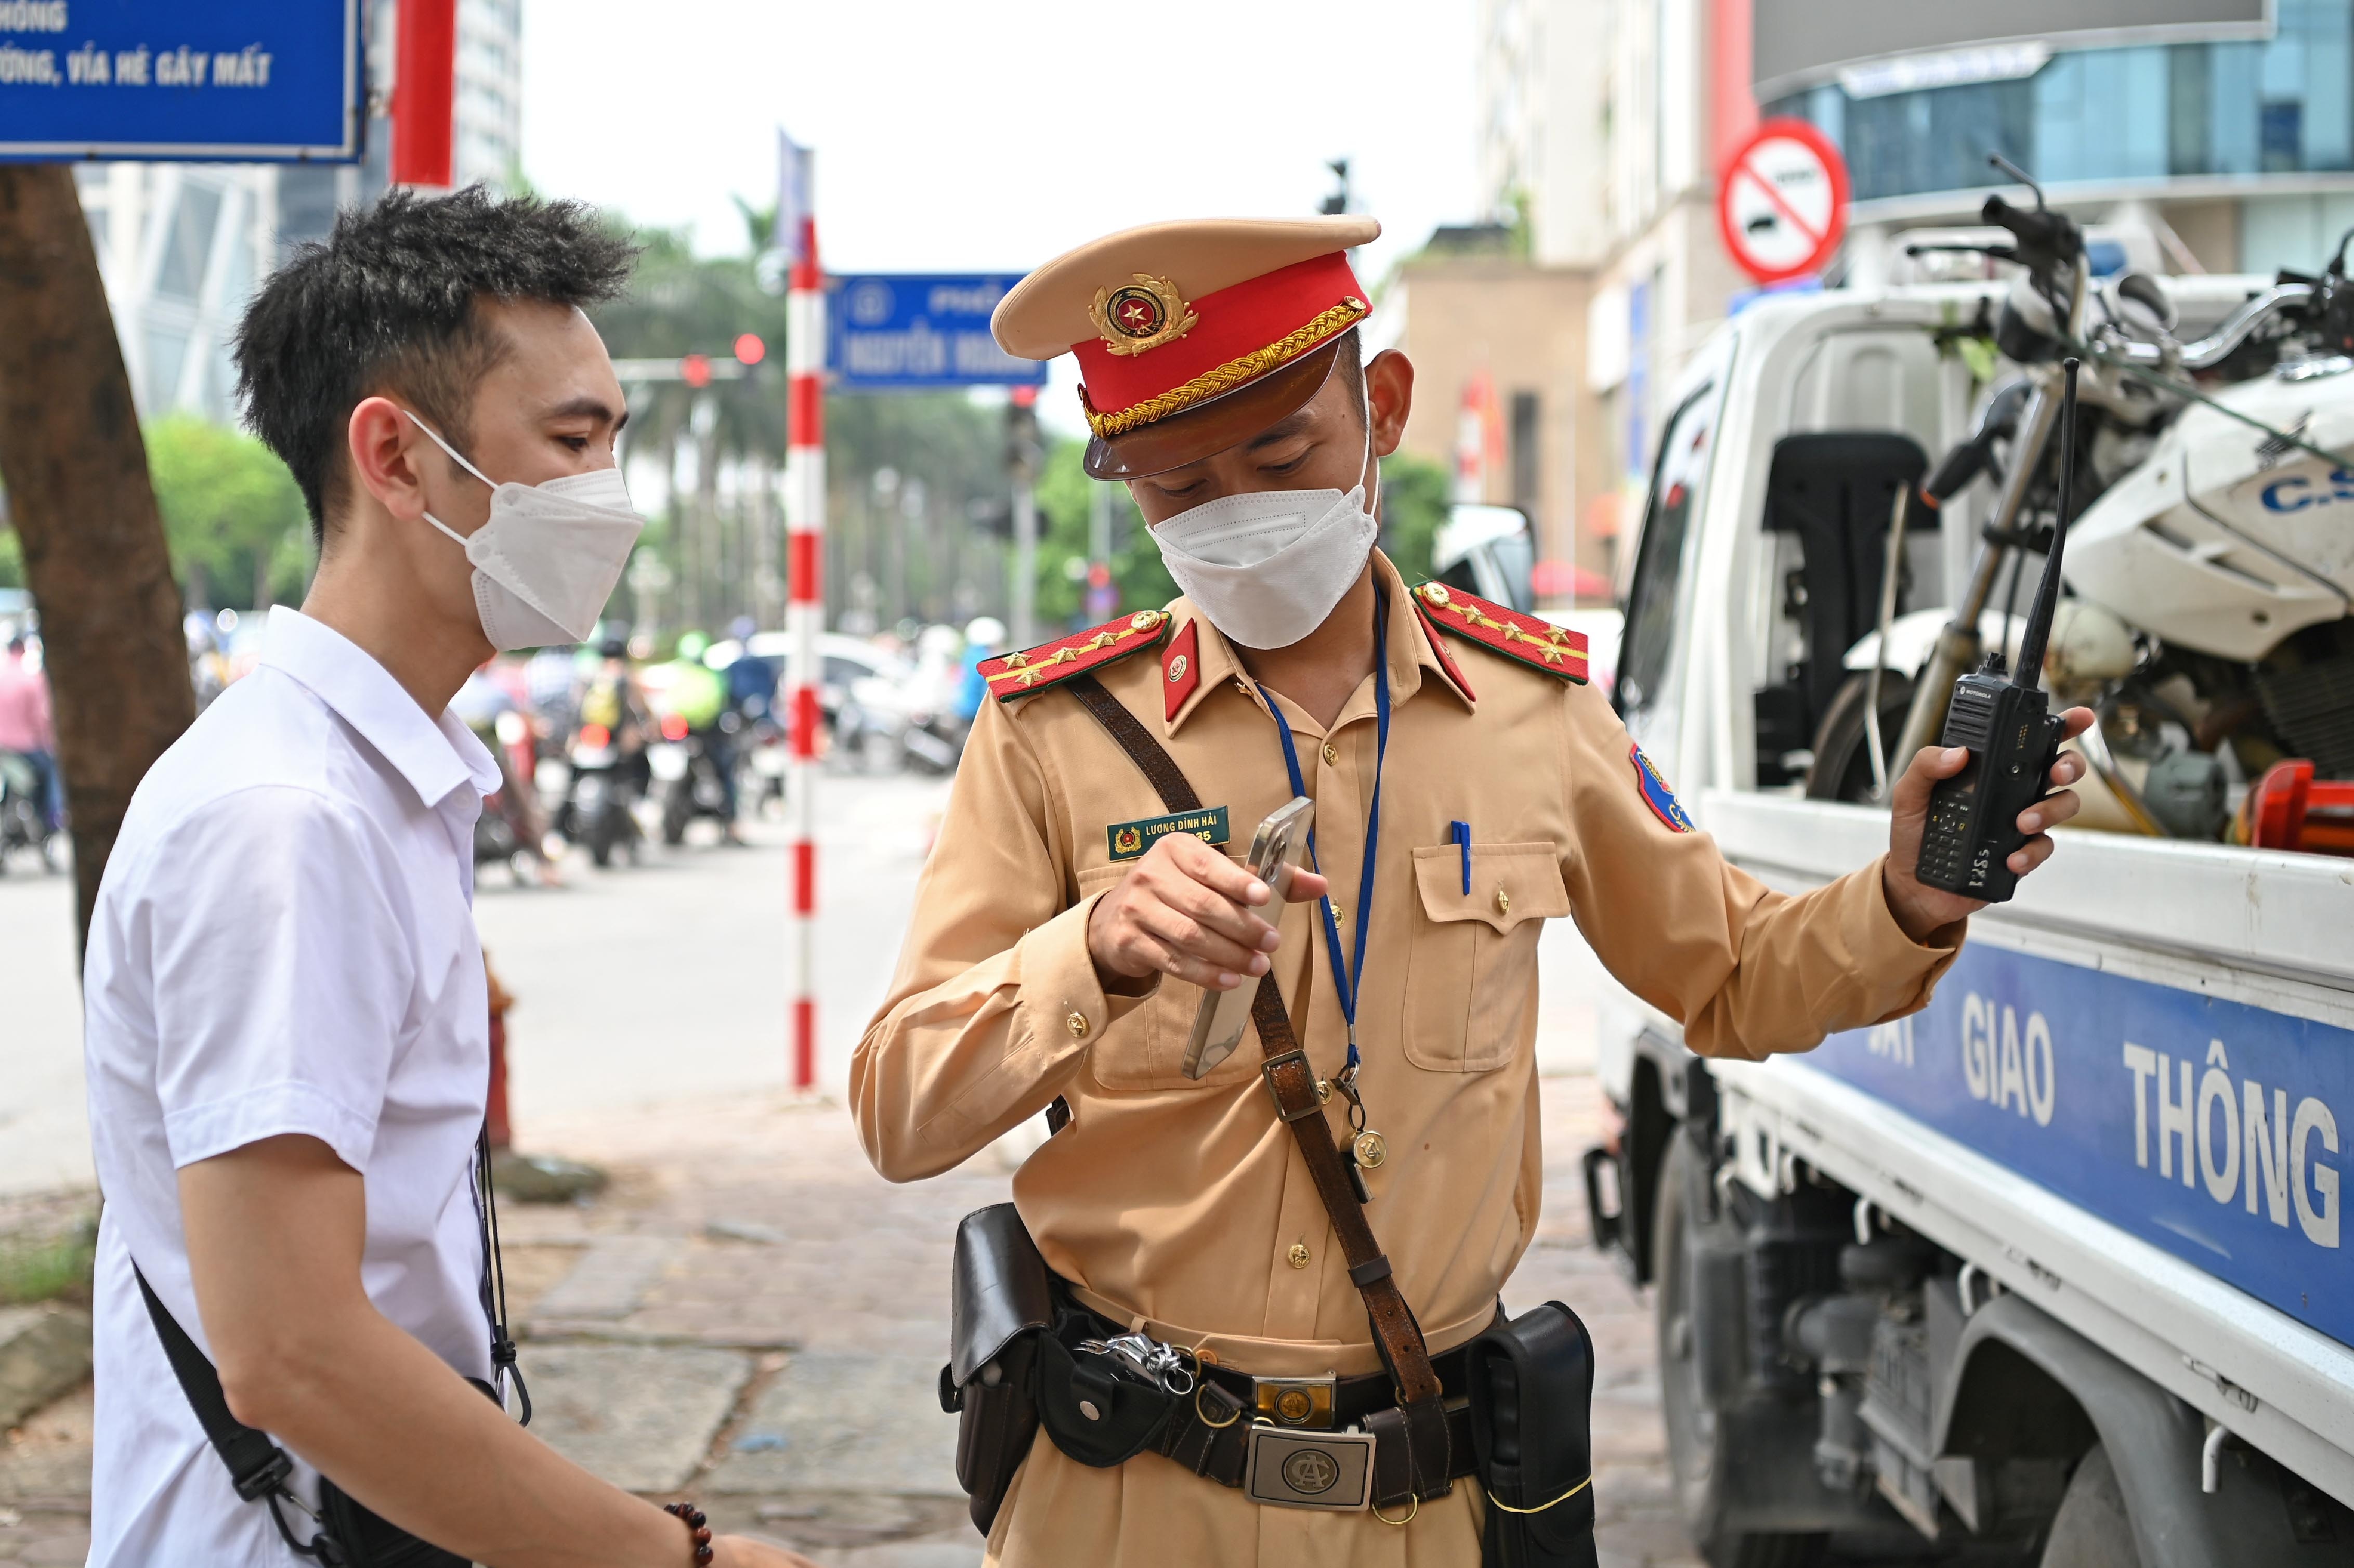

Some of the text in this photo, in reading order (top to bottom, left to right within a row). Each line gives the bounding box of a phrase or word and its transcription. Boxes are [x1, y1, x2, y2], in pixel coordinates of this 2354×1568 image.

[1146, 812, 1217, 835] LƯƠNG ĐÌNH HẢI
[1962, 991, 2055, 1127] GIAO
[2123, 1039, 2339, 1248] THÔNG
